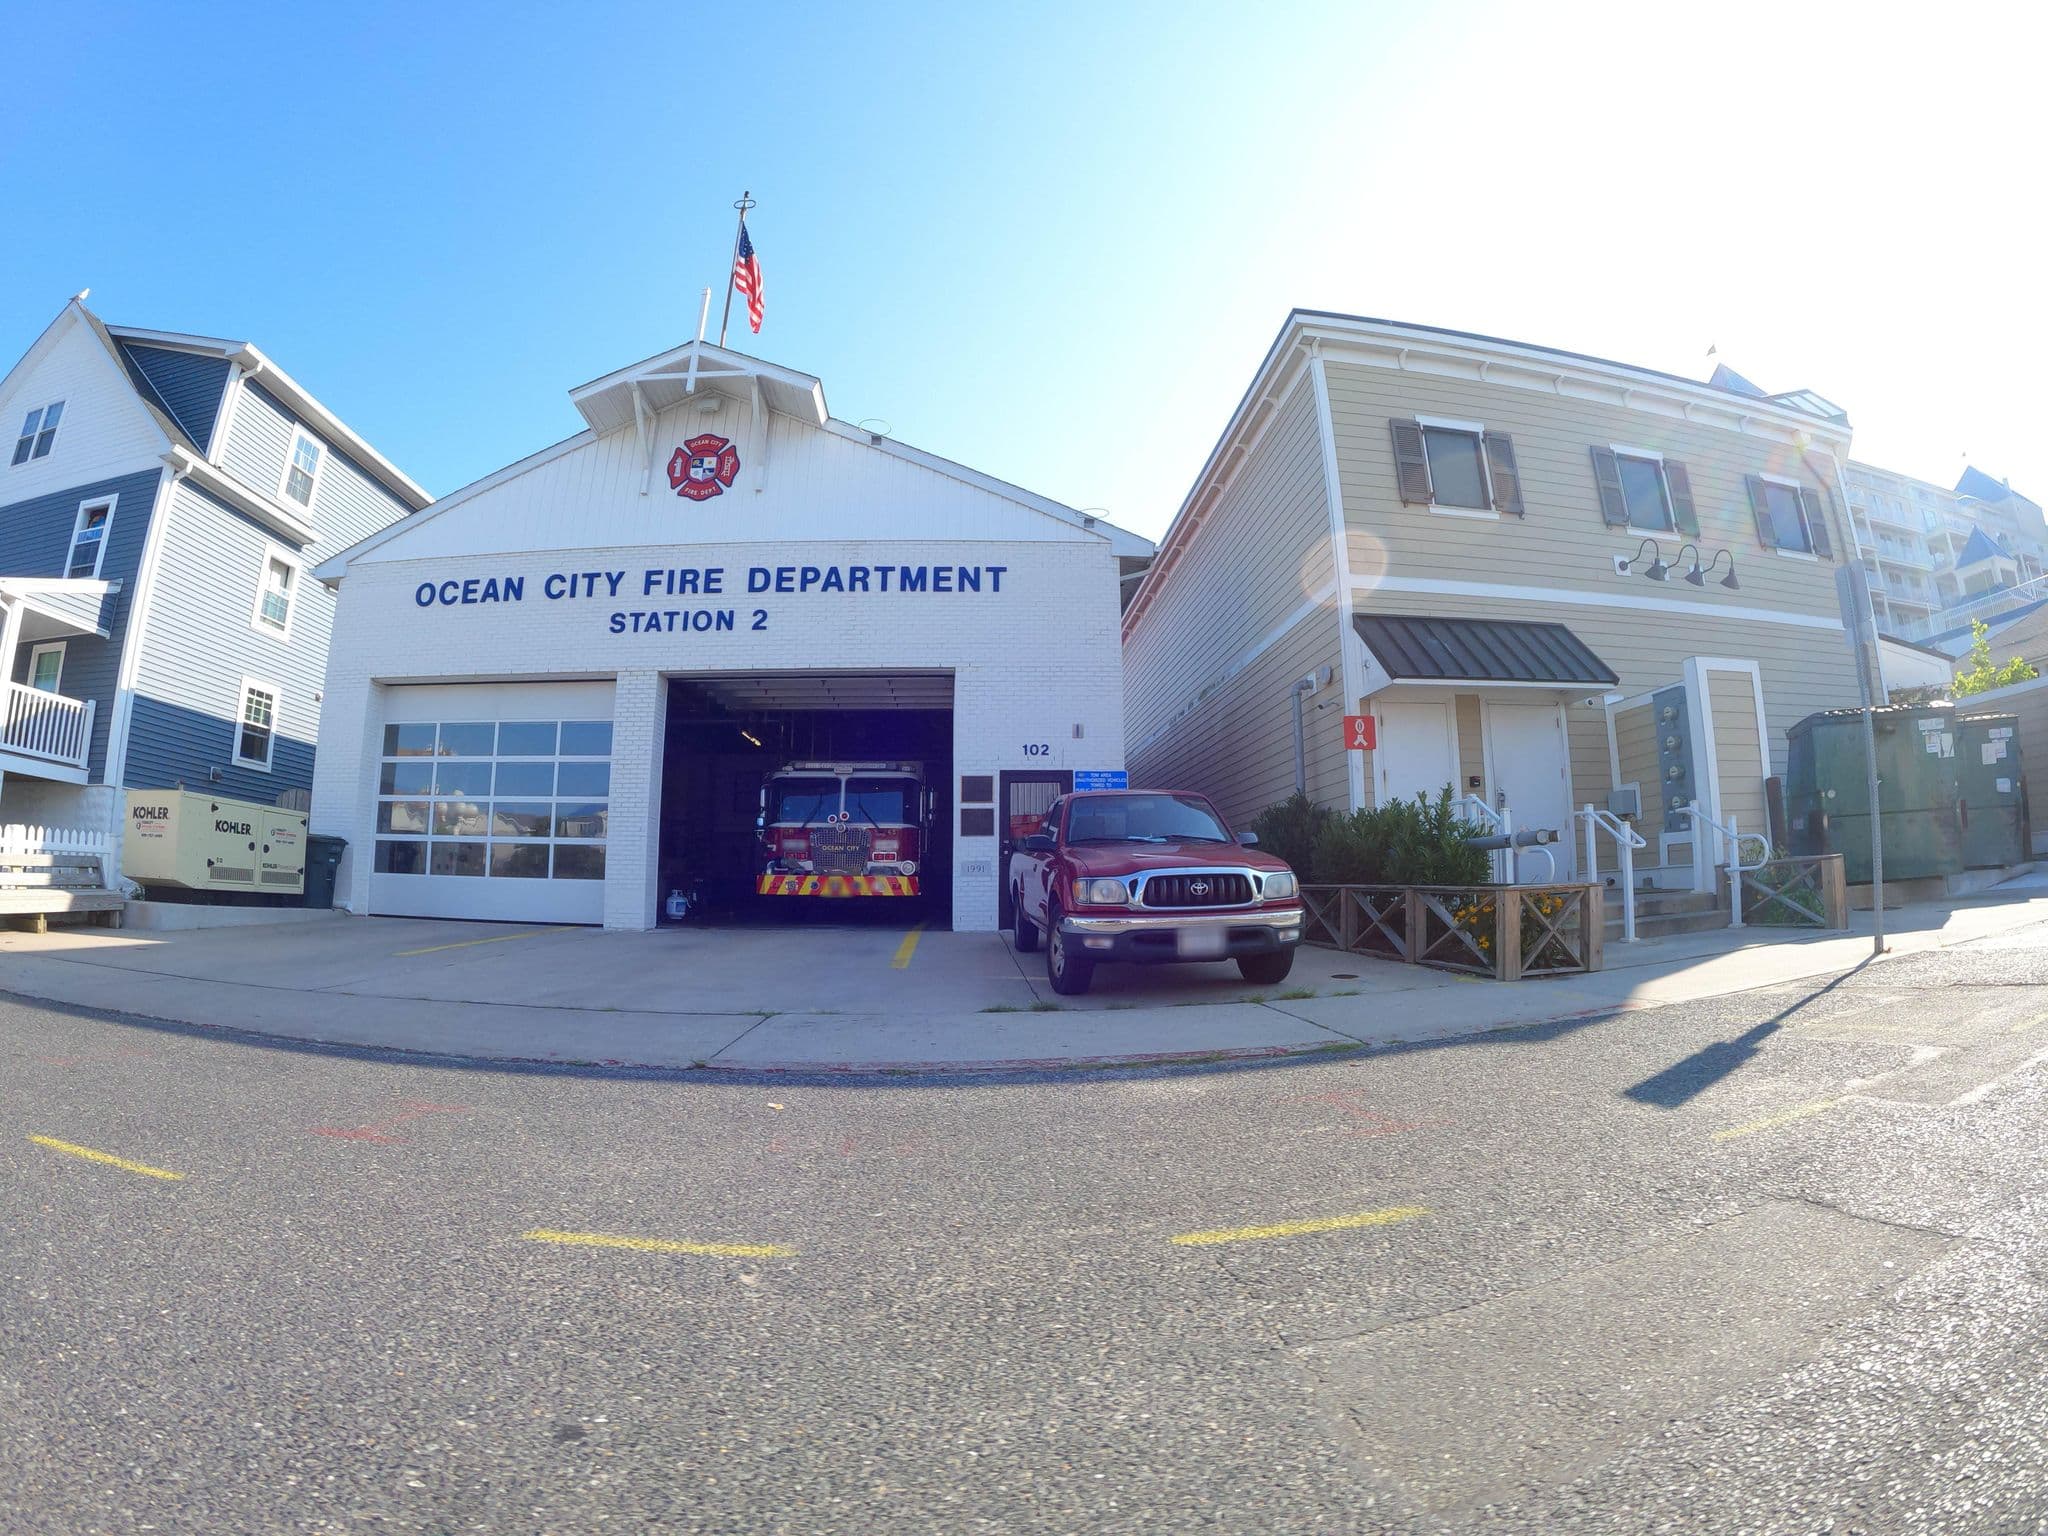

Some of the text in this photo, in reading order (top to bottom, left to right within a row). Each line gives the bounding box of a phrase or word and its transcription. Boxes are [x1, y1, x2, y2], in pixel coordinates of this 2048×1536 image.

[690, 440, 709, 448] OCEAN
[685, 486, 716, 496] FIRE DEPT
[415, 566, 1008, 608] OCEAN CITY FIRE DEPARTMENT
[609, 609, 768, 634] STATION 2
[1022, 743, 1050, 756] 102
[132, 806, 169, 820] KOHLER
[215, 819, 252, 836] KOHLER
[966, 864, 986, 873] 1991
